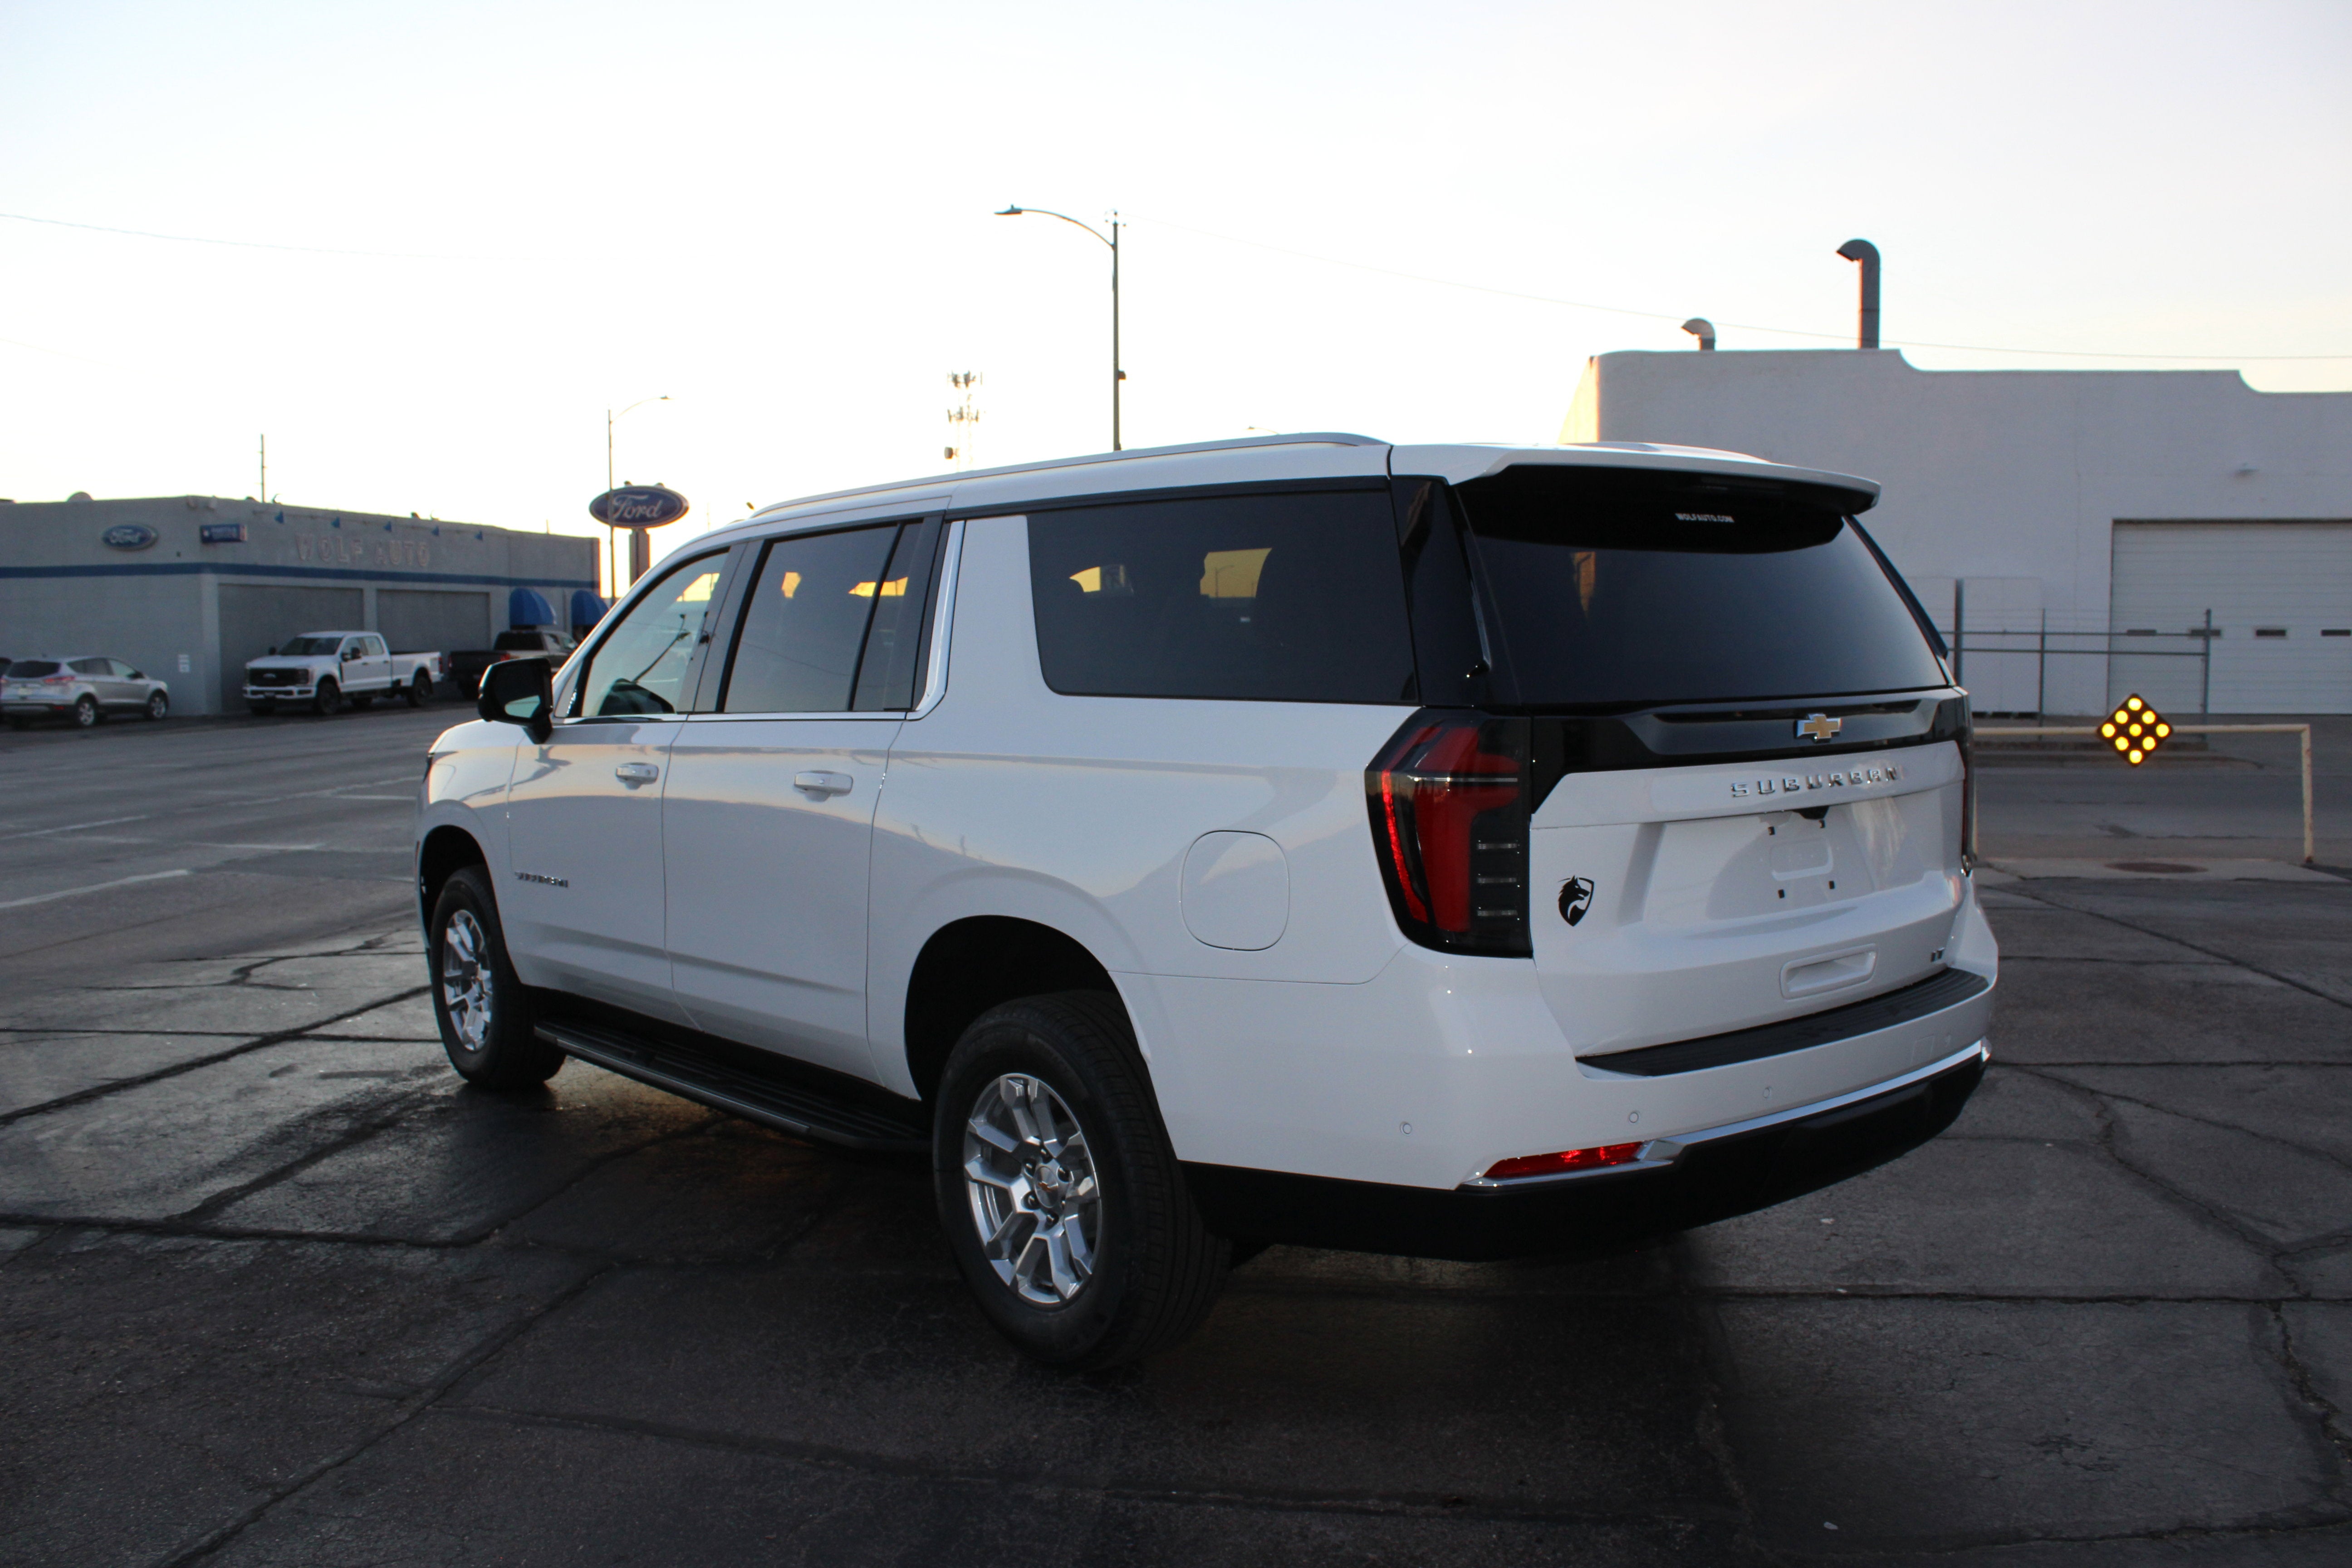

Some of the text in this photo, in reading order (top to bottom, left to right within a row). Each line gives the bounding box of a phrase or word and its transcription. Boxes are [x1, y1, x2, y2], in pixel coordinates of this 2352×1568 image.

[612, 494, 662, 519] Ford
[295, 533, 430, 567] WOLF AUTO
[1730, 767, 1898, 798] SUBURBAN
